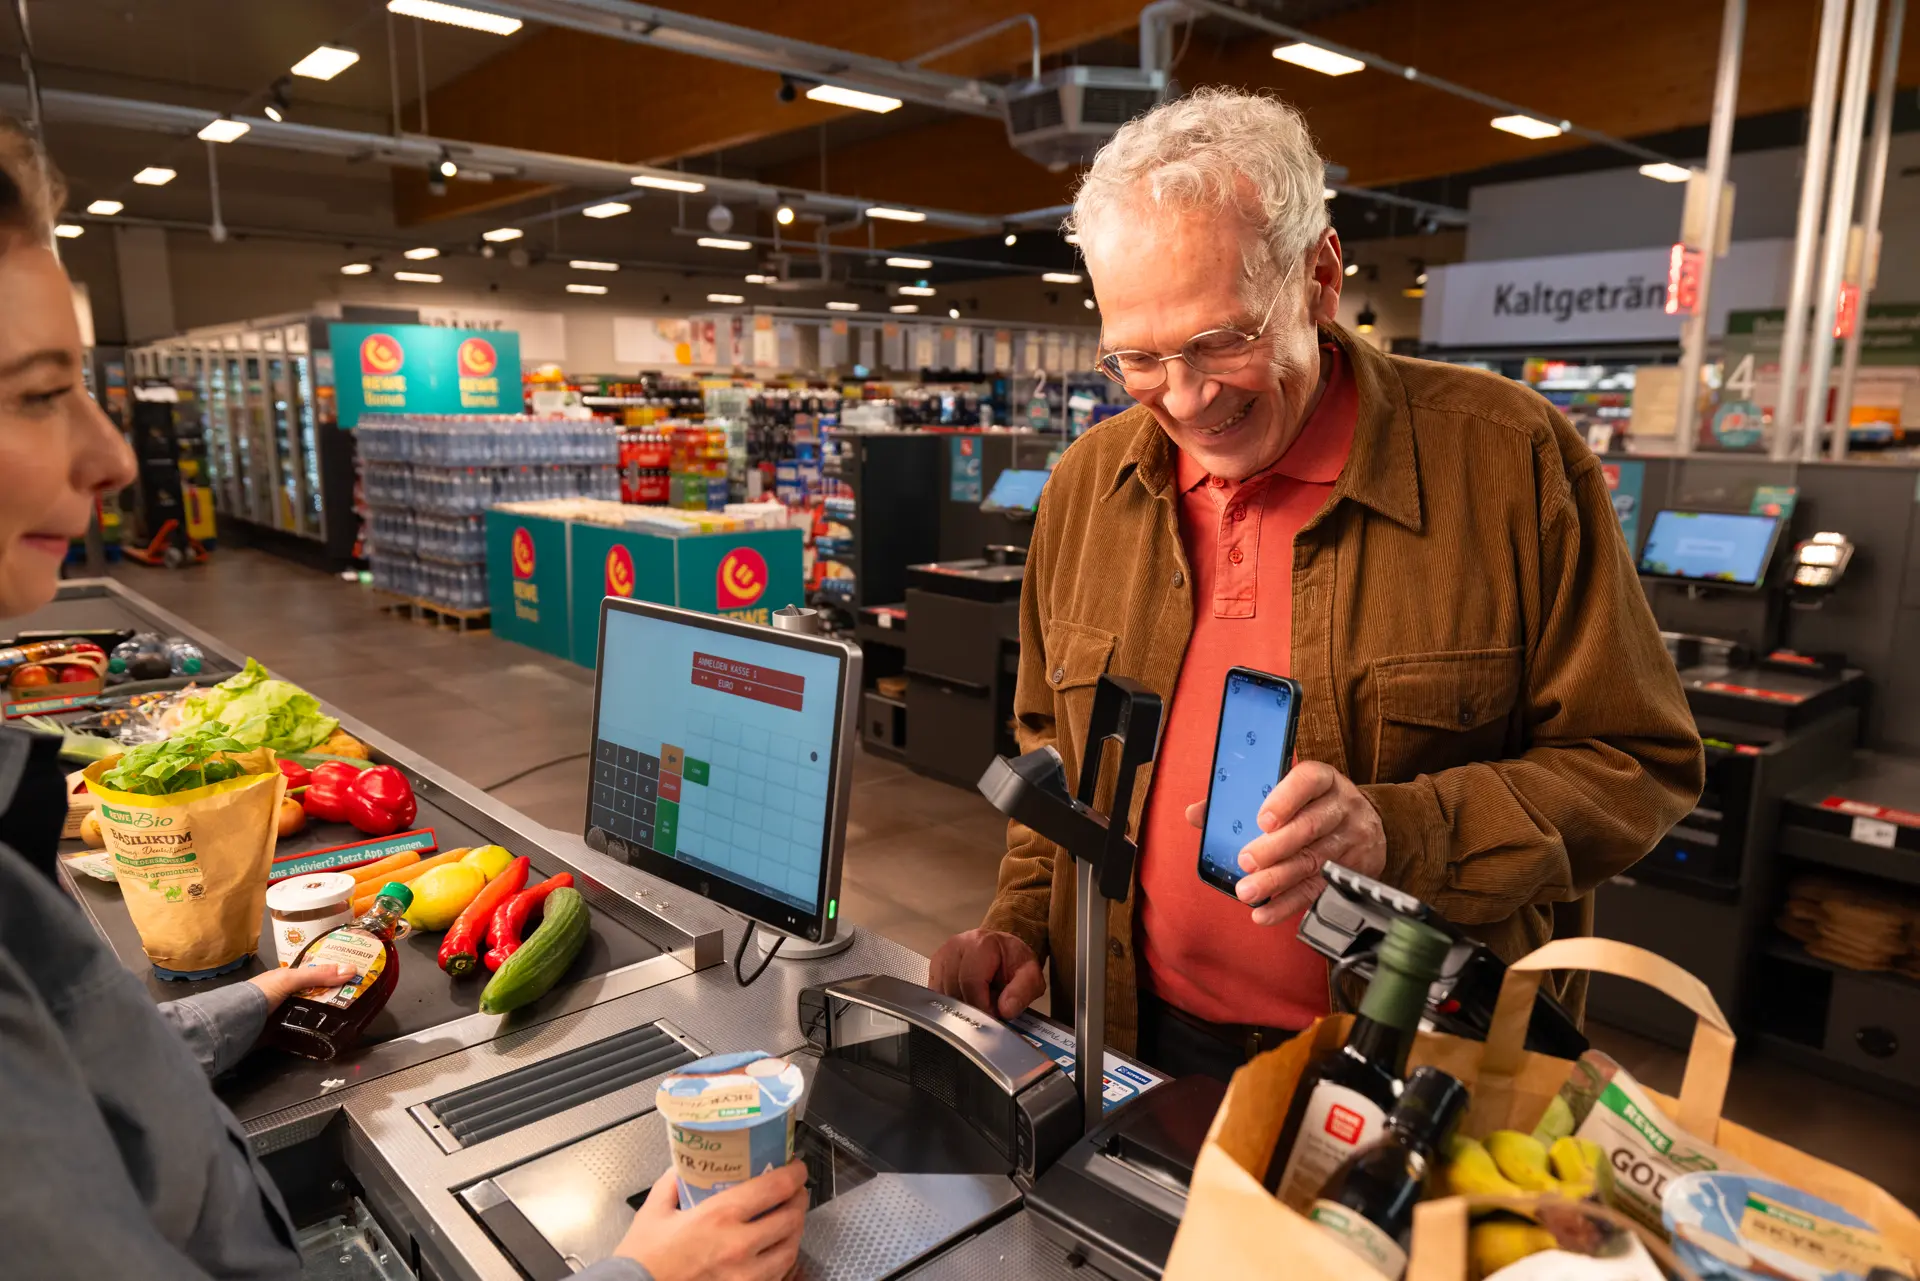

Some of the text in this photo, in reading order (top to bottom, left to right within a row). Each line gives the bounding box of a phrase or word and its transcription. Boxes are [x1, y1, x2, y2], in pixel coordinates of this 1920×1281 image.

[1494, 276, 1666, 322] Kaltgeträn
[1033, 368, 1047, 399] 2
[1726, 353, 1755, 399] 4
[698, 657, 728, 671] ANMELDEN
[730, 664, 750, 677] KASSE
[718, 679, 734, 690] EURO
[605, 748, 610, 756] 7
[646, 762, 651, 770] 9
[603, 770, 649, 793] 4 5 6
[622, 800, 626, 808] 2
[642, 807, 647, 815] 3
[108, 810, 132, 822] REWE
[133, 812, 173, 828] Bio
[110, 828, 193, 845] BASILIKUM
[289, 856, 334, 876] aktiviert?
[337, 852, 363, 866] Jetzt
[364, 849, 383, 862] App
[385, 840, 425, 855] scannen.
[150, 867, 199, 878] aromatisch
[325, 943, 374, 960] AHORNSIRUP
[351, 937, 372, 948] Bio
[338, 999, 347, 1007] ml
[1622, 1102, 1669, 1151] REWE
[682, 1131, 722, 1151] Bio
